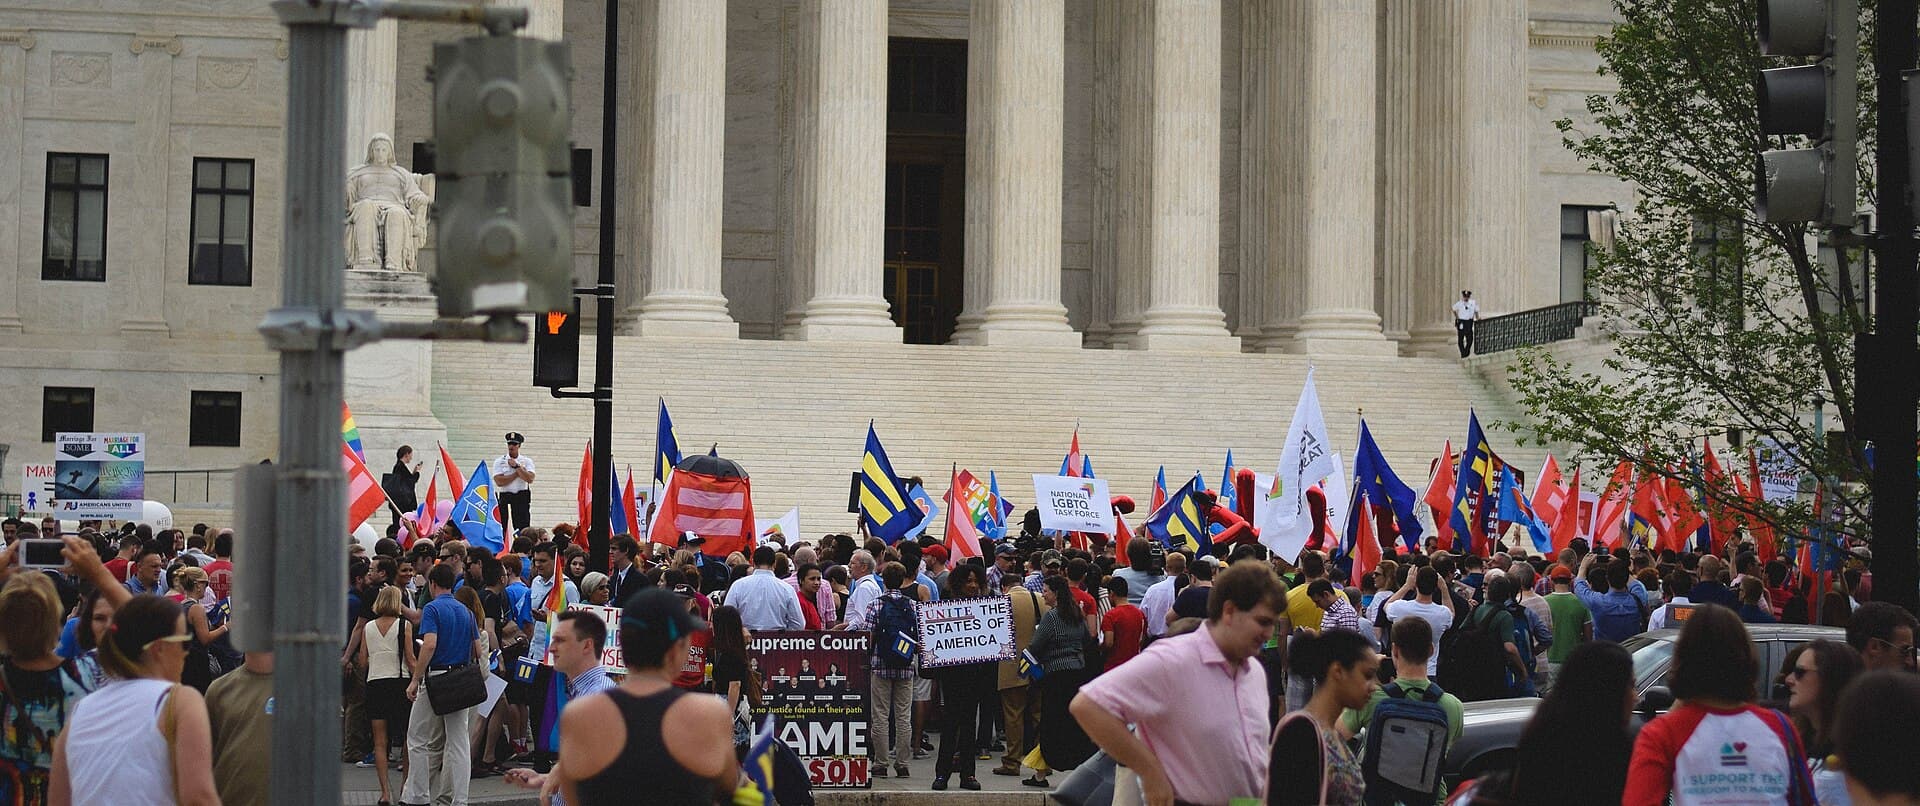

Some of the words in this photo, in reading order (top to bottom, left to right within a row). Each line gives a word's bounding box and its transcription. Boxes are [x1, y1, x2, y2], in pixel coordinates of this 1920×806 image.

[112, 445, 132, 453] ALL
[1050, 490, 1087, 499] NATIONAL
[1052, 498, 1089, 510] LGBTQ
[1075, 510, 1101, 518] FORCE
[925, 607, 973, 619] UNITE
[979, 602, 1006, 616] THE
[926, 619, 981, 635] STATES
[987, 617, 1004, 629] OF
[746, 637, 815, 654] upreme
[820, 634, 868, 650] Court
[935, 634, 998, 650] AMERICA
[768, 706, 792, 714] Justice
[845, 706, 862, 715] path
[1690, 773, 1755, 785] SUPPORT
[1762, 773, 1784, 784] THE
